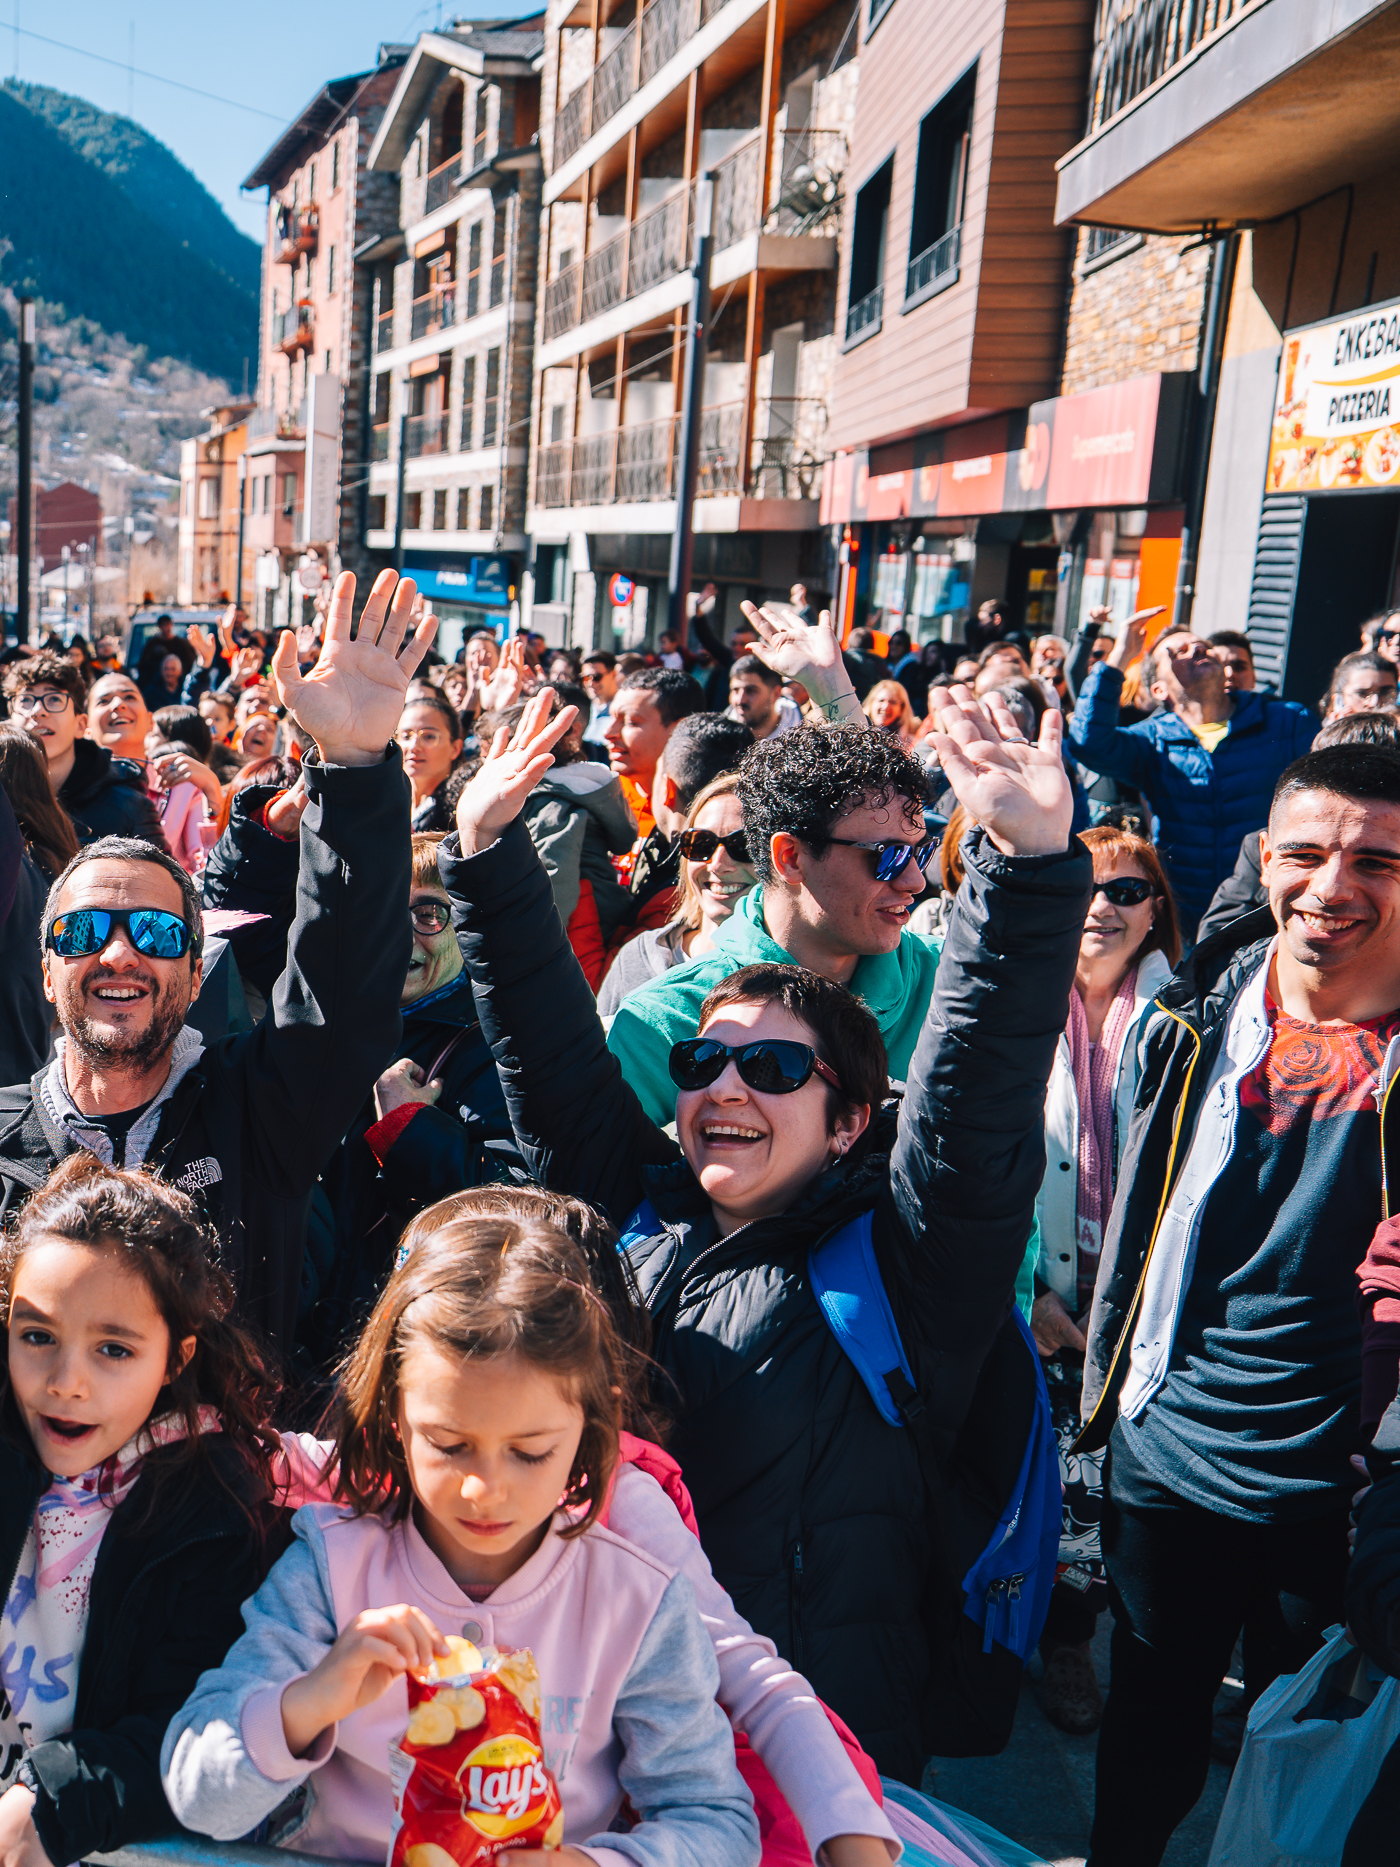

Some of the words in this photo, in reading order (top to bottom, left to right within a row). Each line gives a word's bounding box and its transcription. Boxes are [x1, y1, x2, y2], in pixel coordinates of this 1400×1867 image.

[1328, 387, 1390, 426] PIZZERIA
[184, 1158, 207, 1172] THE
[176, 1167, 209, 1188] NORTH
[186, 1176, 210, 1193] FACE
[468, 1754, 548, 1820] Lay's
